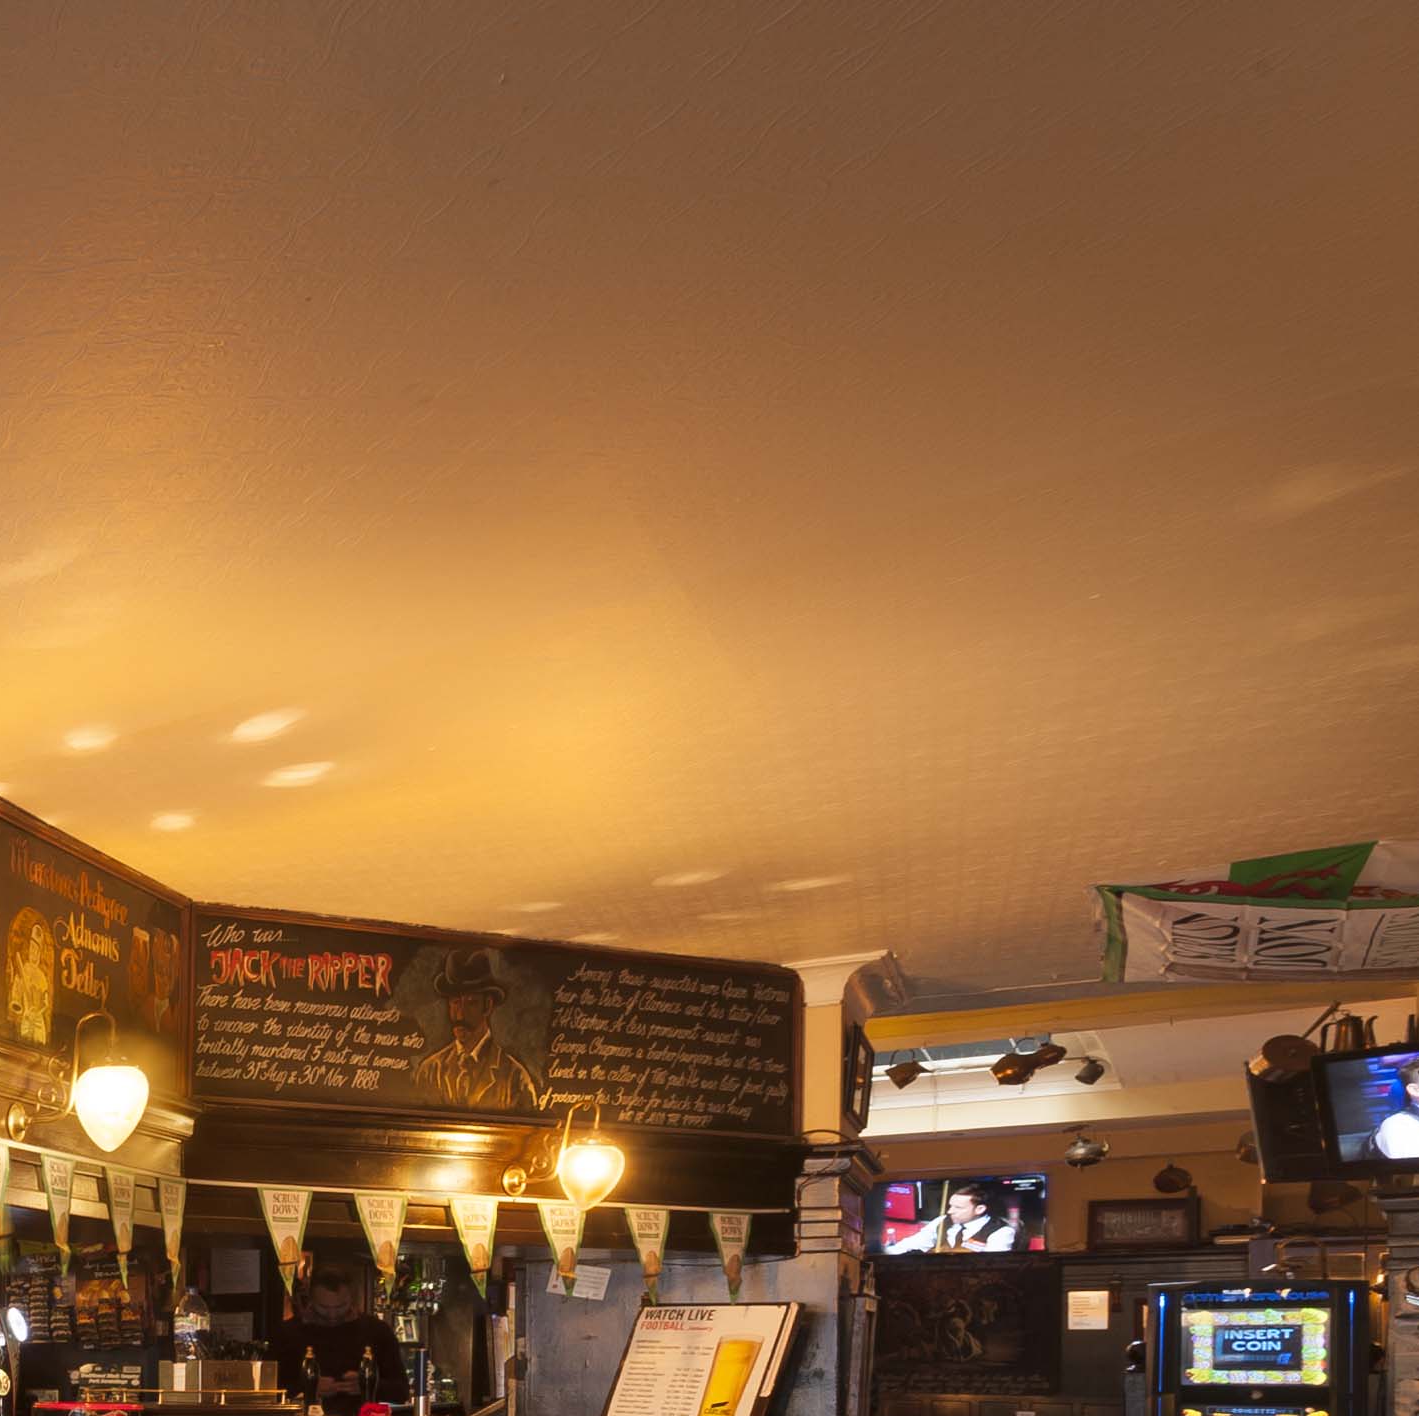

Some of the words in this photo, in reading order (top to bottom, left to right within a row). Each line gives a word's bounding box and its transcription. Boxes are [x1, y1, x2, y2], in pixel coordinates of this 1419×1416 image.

[201, 922, 246, 949] Who
[210, 947, 282, 989] JACK
[279, 956, 306, 979] THE
[307, 952, 394, 998] RIPPER
[196, 983, 229, 1008] There
[231, 988, 262, 1010] have
[293, 1000, 349, 1018] numerous
[350, 1002, 401, 1025] attempts
[263, 1017, 282, 1036] the
[286, 1019, 333, 1049] identity
[335, 1022, 353, 1049] of
[353, 1024, 371, 1044] the
[196, 1033, 250, 1064] brutally
[250, 1042, 312, 1061] murdered
[272, 1192, 300, 1204] SCRUM
[272, 1204, 300, 1215] DOWN
[645, 1309, 686, 1321] WATCH
[687, 1310, 716, 1321] LIVE
[640, 1321, 685, 1331] FOOTBALL
[1224, 1329, 1295, 1340] INSERT
[1231, 1341, 1282, 1351] COIN
